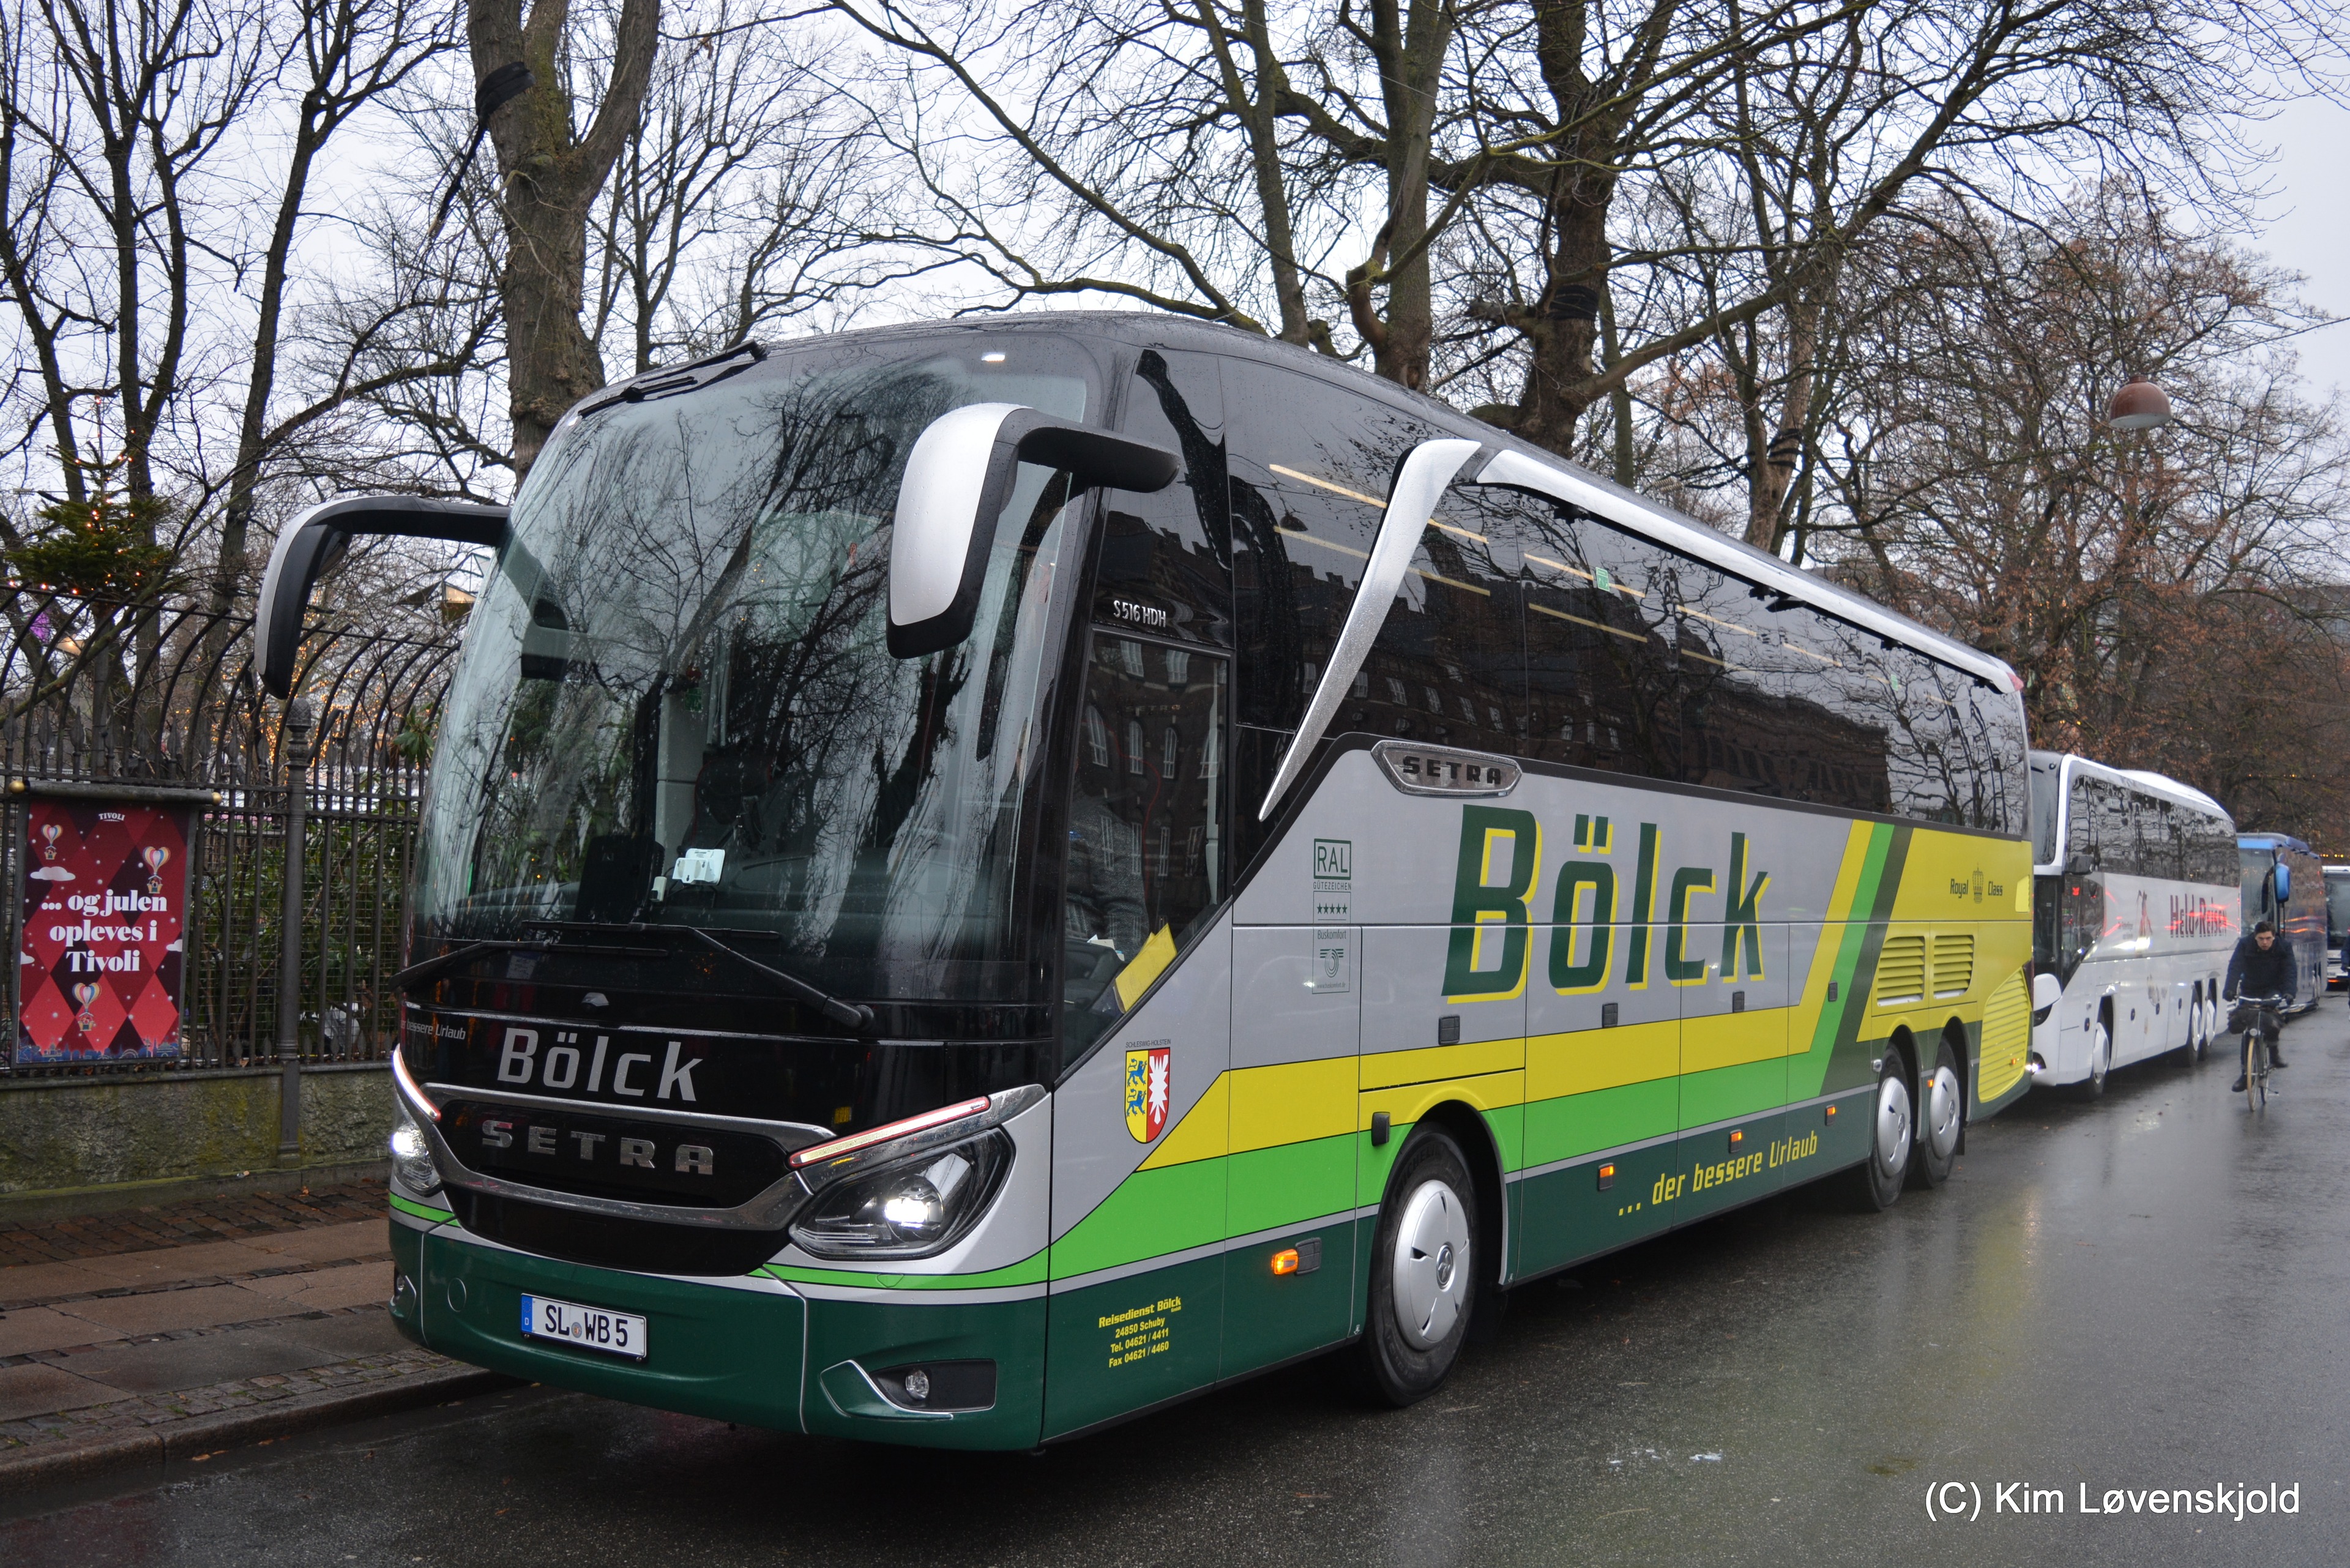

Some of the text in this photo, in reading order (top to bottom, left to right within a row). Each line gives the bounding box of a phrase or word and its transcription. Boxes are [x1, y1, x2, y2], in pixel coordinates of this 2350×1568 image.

[1122, 602, 1141, 622] 516
[1141, 606, 1166, 628] HDH
[1403, 755, 1501, 785] SETRA
[99, 812, 125, 821] TIVOLI
[1318, 846, 1348, 873] RAL
[1313, 880, 1352, 890] GÜTEZEICHEN
[1950, 878, 2003, 898] Royal Class
[68, 895, 101, 917] og
[99, 889, 168, 917] julen
[1441, 804, 1772, 1004] Bölck
[50, 919, 158, 947] opleves i
[1317, 929, 1347, 940] Buskomfort
[65, 949, 140, 972] Tivoli
[406, 1018, 434, 1035] bessere
[435, 1023, 466, 1040] Urlaub
[1125, 1039, 1171, 1048] SCHLESWIG-HOLSTEIN
[497, 1028, 704, 1102] Bölck
[482, 1120, 714, 1176] SETRA
[1652, 1173, 1686, 1205] der
[1692, 1152, 1763, 1193] bessere
[1769, 1130, 1818, 1168] Urlaub
[524, 1317, 529, 1326] D
[1099, 1296, 1182, 1328] Reisedienst Bölck
[545, 1304, 628, 1347] SL WB 5
[1115, 1316, 1166, 1338] 24850 Schuby
[1110, 1342, 1124, 1353] Tel.
[1125, 1334, 1147, 1349] 04621
[1152, 1327, 1169, 1340] 4411
[1108, 1357, 1123, 1368] Fax
[1124, 1348, 1146, 1363] 04621
[1151, 1340, 1169, 1354] 4460
